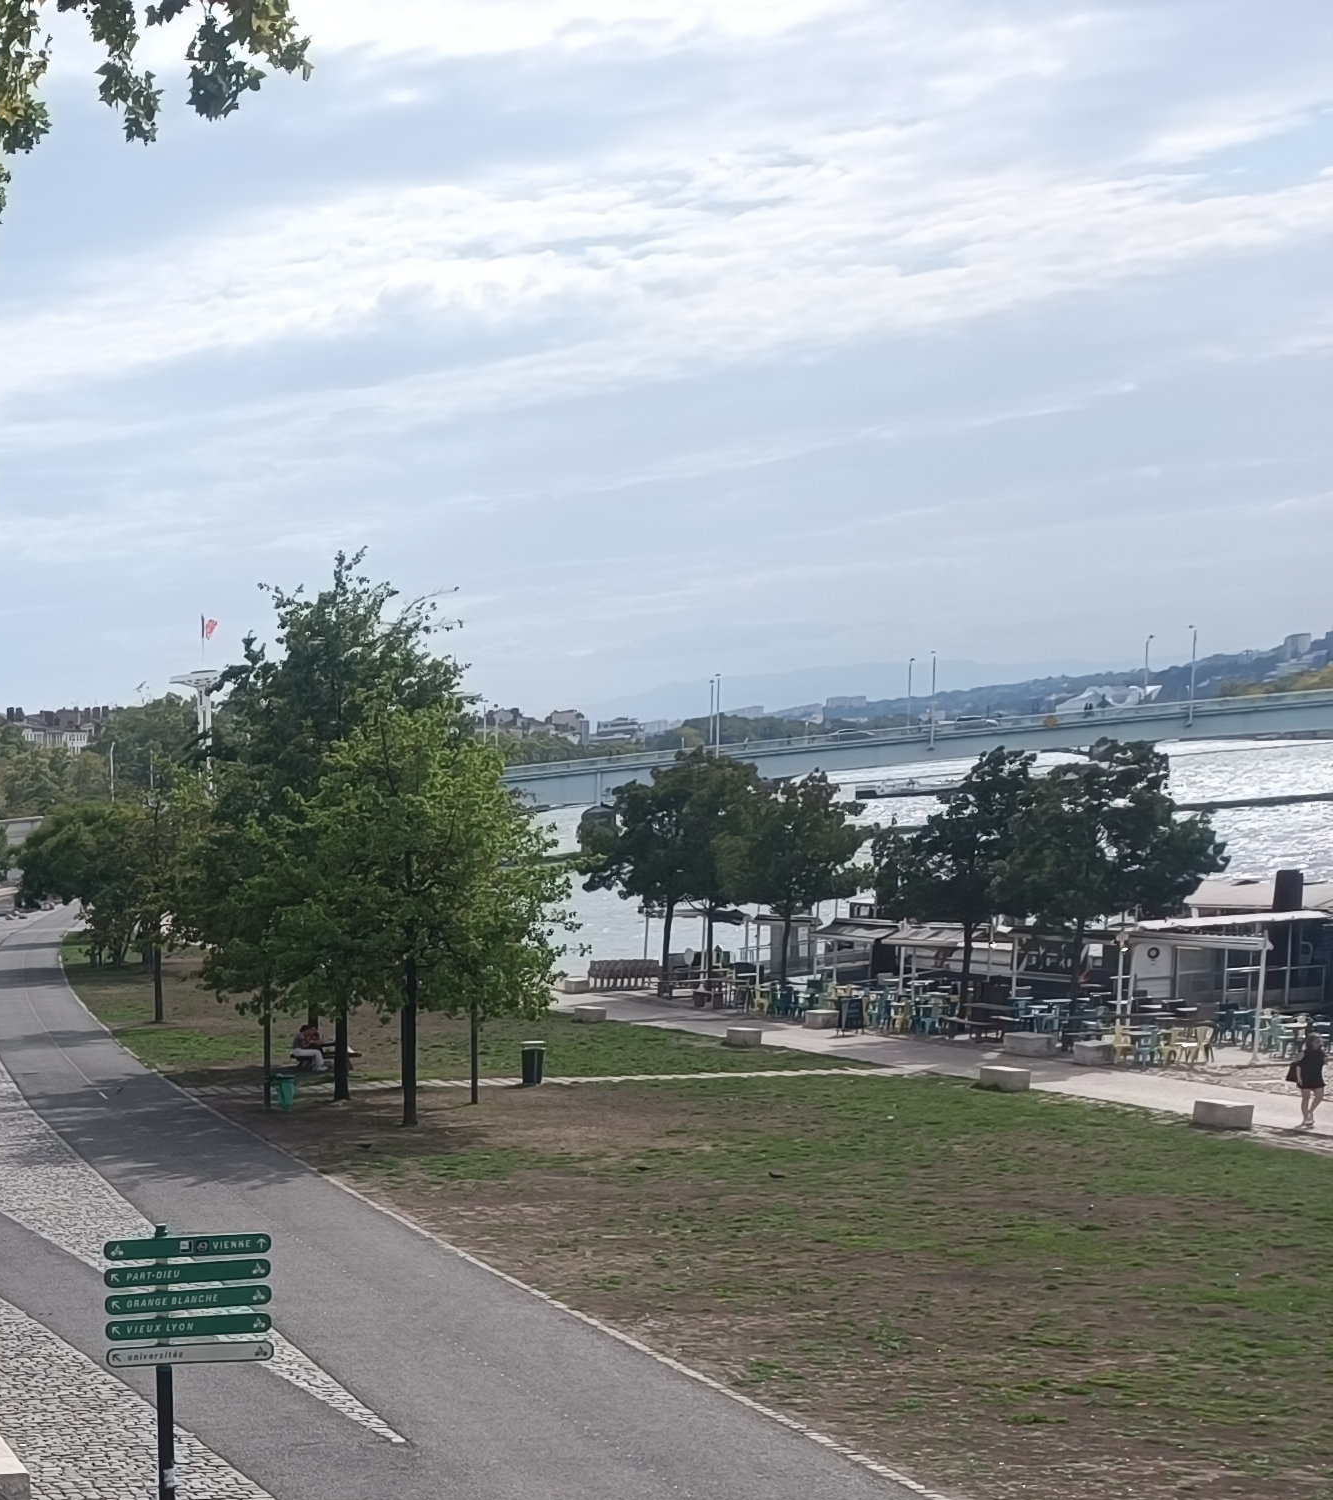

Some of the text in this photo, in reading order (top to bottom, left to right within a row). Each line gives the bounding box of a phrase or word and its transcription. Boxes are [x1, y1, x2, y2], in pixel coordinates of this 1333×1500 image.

[212, 1239, 251, 1251] VIENNE
[126, 1270, 180, 1281] PART-DIEU
[126, 1294, 219, 1308] GRANGE BLANCHE
[126, 1322, 194, 1334] VIEUX LYON
[127, 1350, 184, 1361] universités
